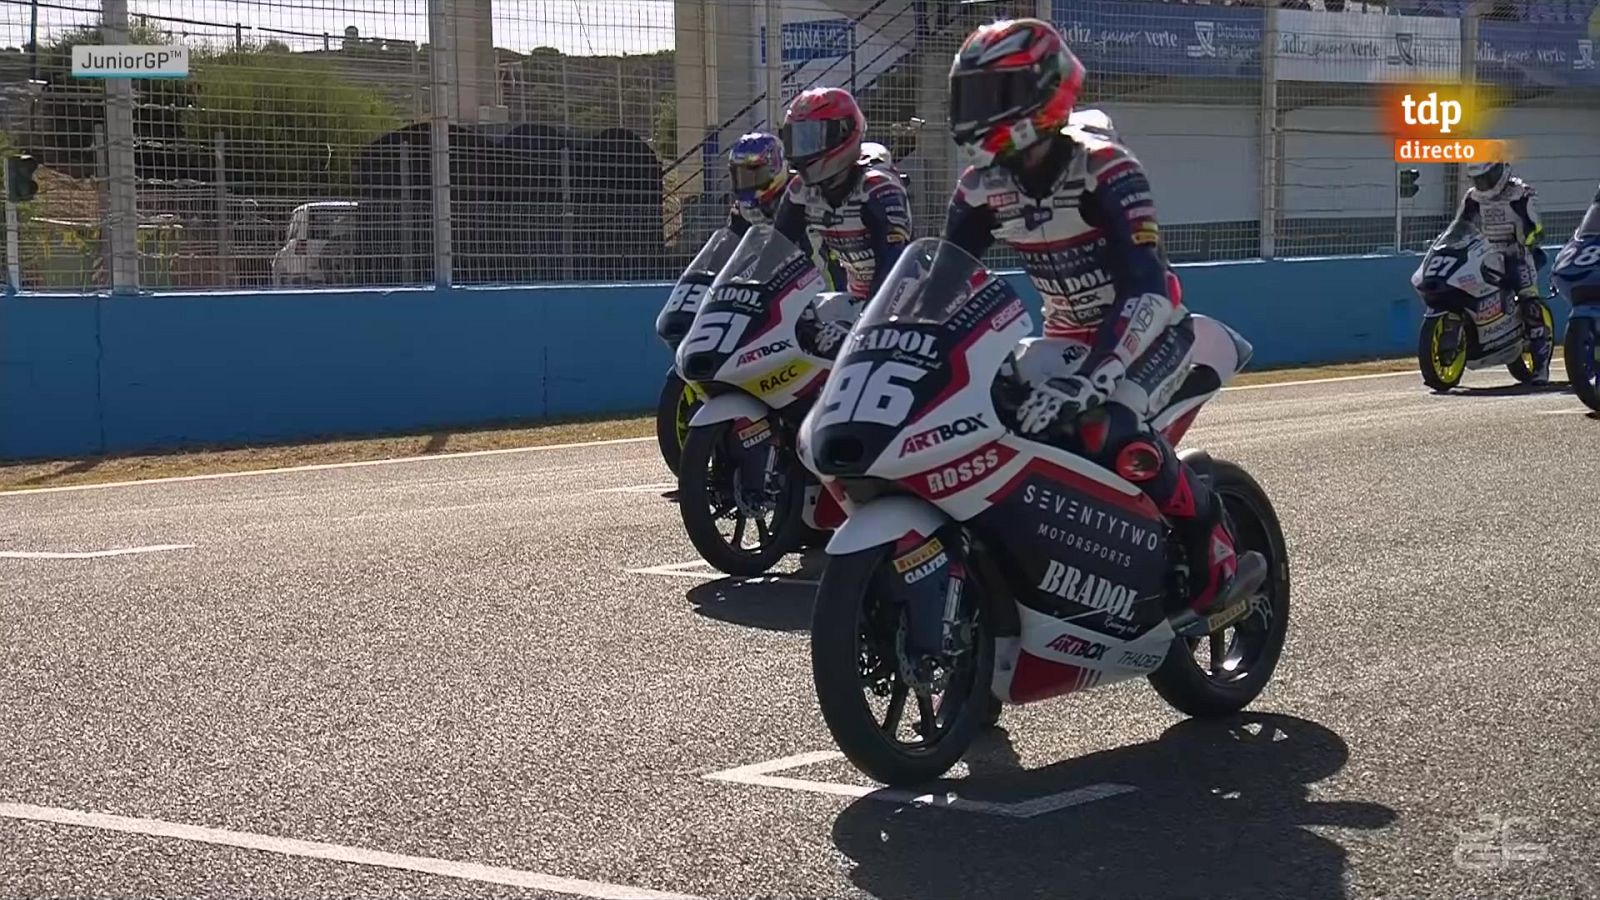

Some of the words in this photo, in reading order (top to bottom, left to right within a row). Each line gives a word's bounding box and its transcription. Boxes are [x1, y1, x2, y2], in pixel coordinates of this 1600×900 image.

[784, 30, 820, 50] BUNA
[1424, 256, 1458, 277] 27
[684, 311, 752, 354] 51
[736, 339, 793, 367] ARTBOX
[760, 365, 798, 392] RACC
[815, 361, 928, 432] 96
[899, 413, 989, 458] ARTBOX
[927, 449, 999, 494] ROSSS
[1023, 484, 1159, 551] SEVENTYTWO
[1038, 523, 1132, 568] MOTORSPORTS
[904, 552, 948, 584] GALFER
[1038, 559, 1139, 621] BRADOL
[1045, 633, 1112, 660] ARTBOX
